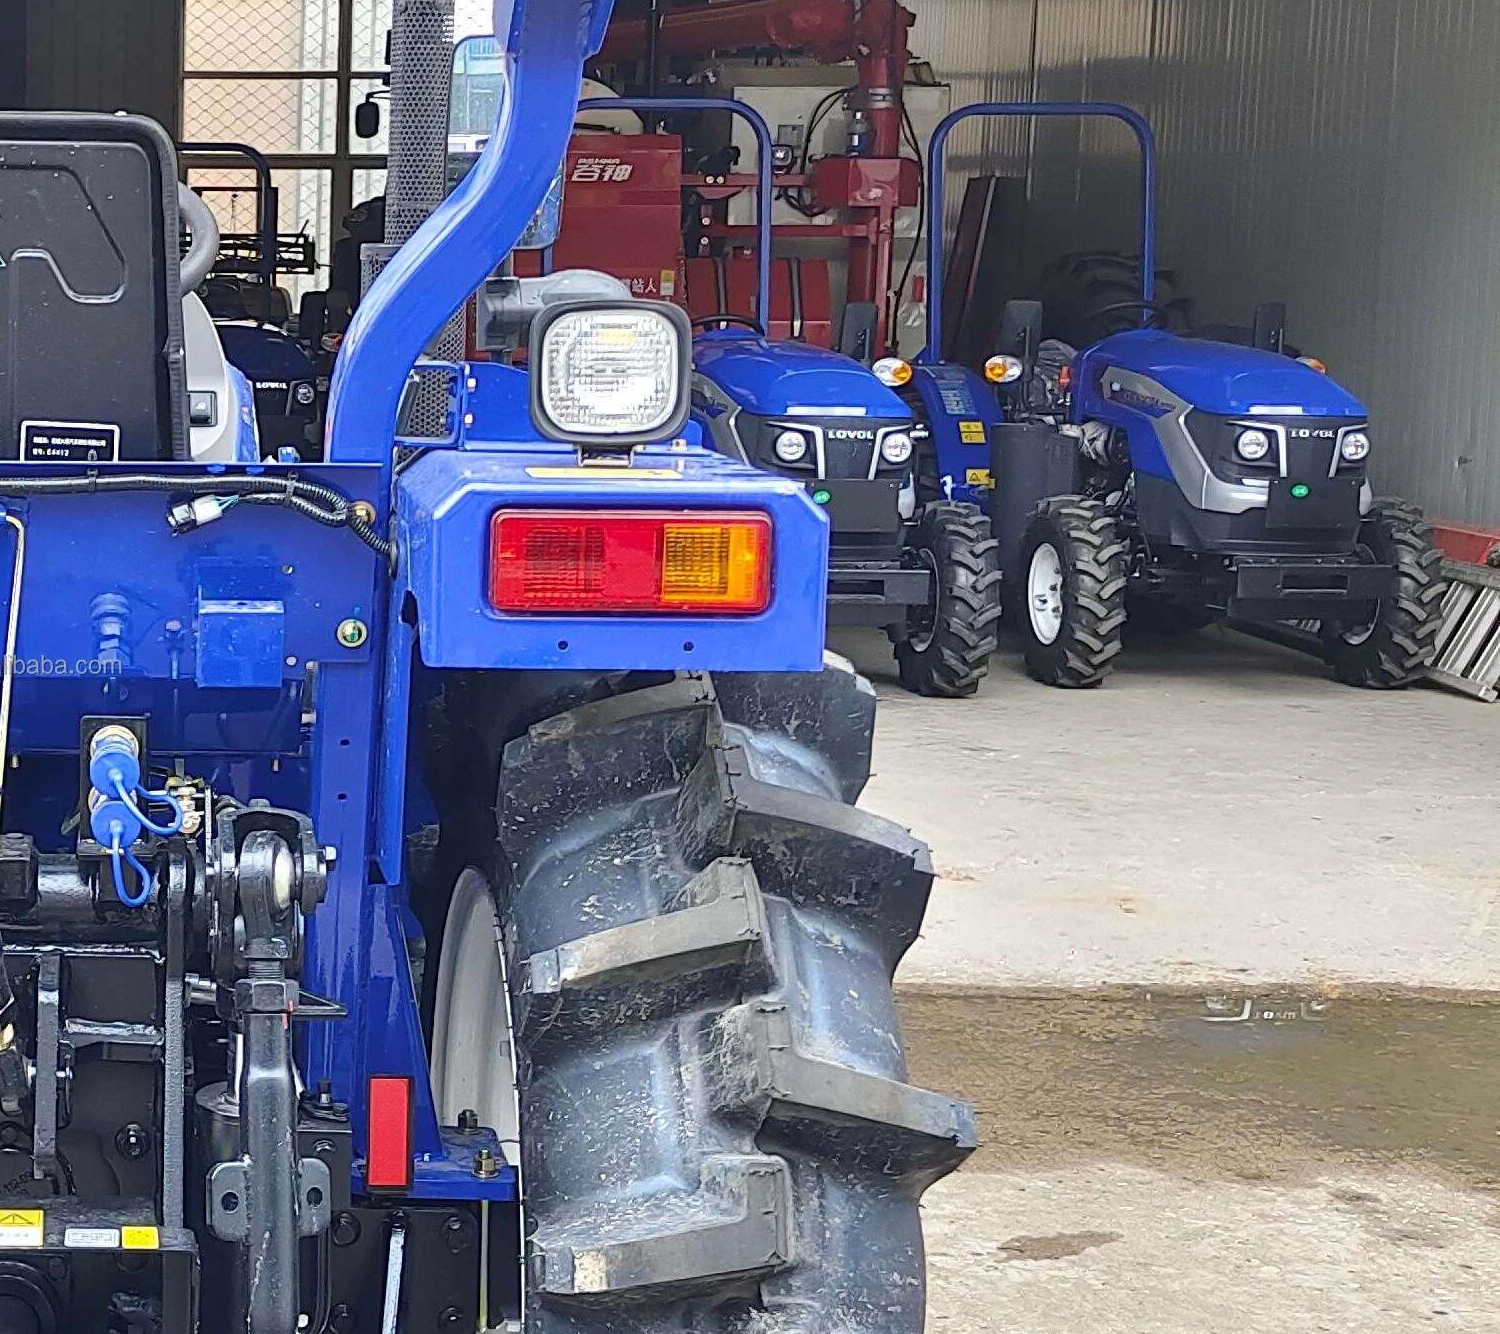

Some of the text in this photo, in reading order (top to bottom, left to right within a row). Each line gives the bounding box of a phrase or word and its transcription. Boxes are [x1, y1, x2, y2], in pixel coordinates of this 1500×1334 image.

[571, 165, 634, 182] 谷神
[827, 429, 875, 440] LOVOL
[1289, 428, 1335, 439] LOVOL
